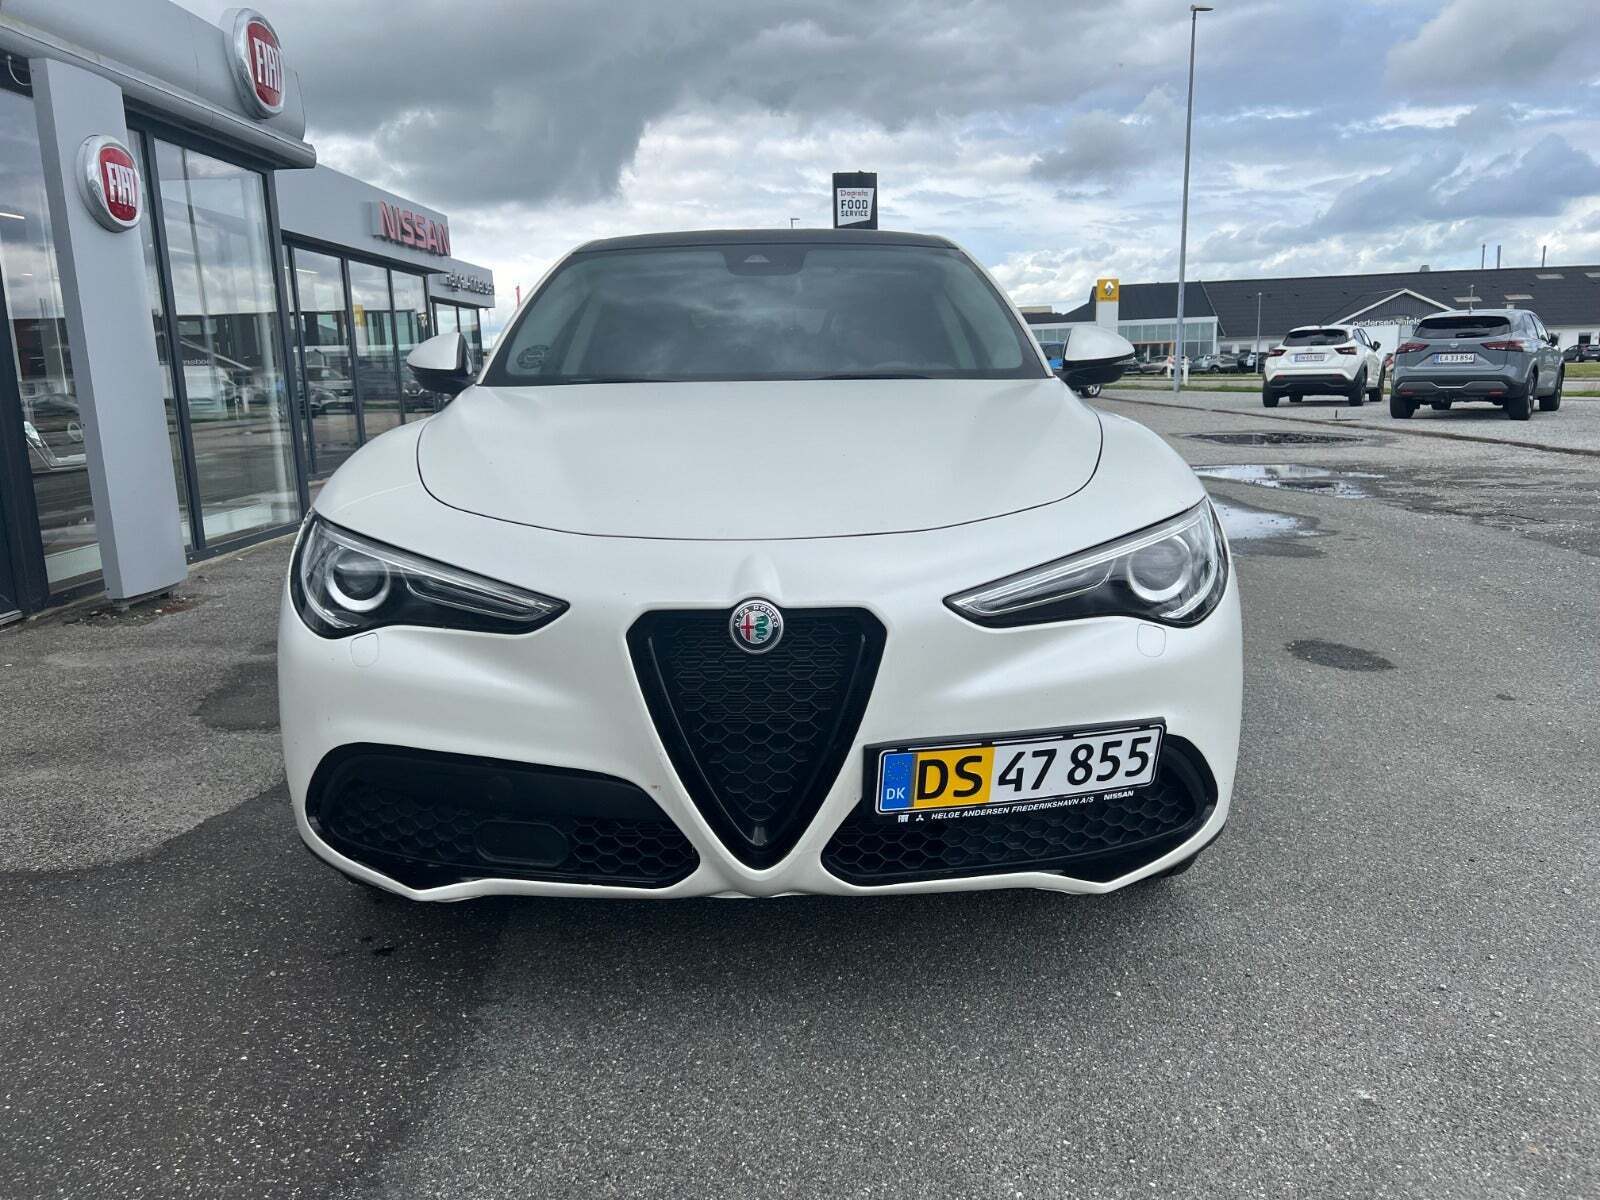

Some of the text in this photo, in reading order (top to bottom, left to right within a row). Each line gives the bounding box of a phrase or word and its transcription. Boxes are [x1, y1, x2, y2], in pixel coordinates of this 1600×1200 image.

[253, 37, 282, 93] FIAT
[105, 162, 139, 207] FIAT
[841, 200, 868, 209] FOOD
[379, 200, 451, 256] NISSAN
[735, 605, 779, 628] ALFA ROMEO
[886, 736, 1152, 800] DK DS 47 855
[931, 811, 960, 820] HELGE
[962, 806, 1009, 818] ANDERSEN
[1010, 797, 1079, 814] FREDERIKSHAVN
[1079, 795, 1094, 804] A/S
[1103, 790, 1134, 801] NISSAN
